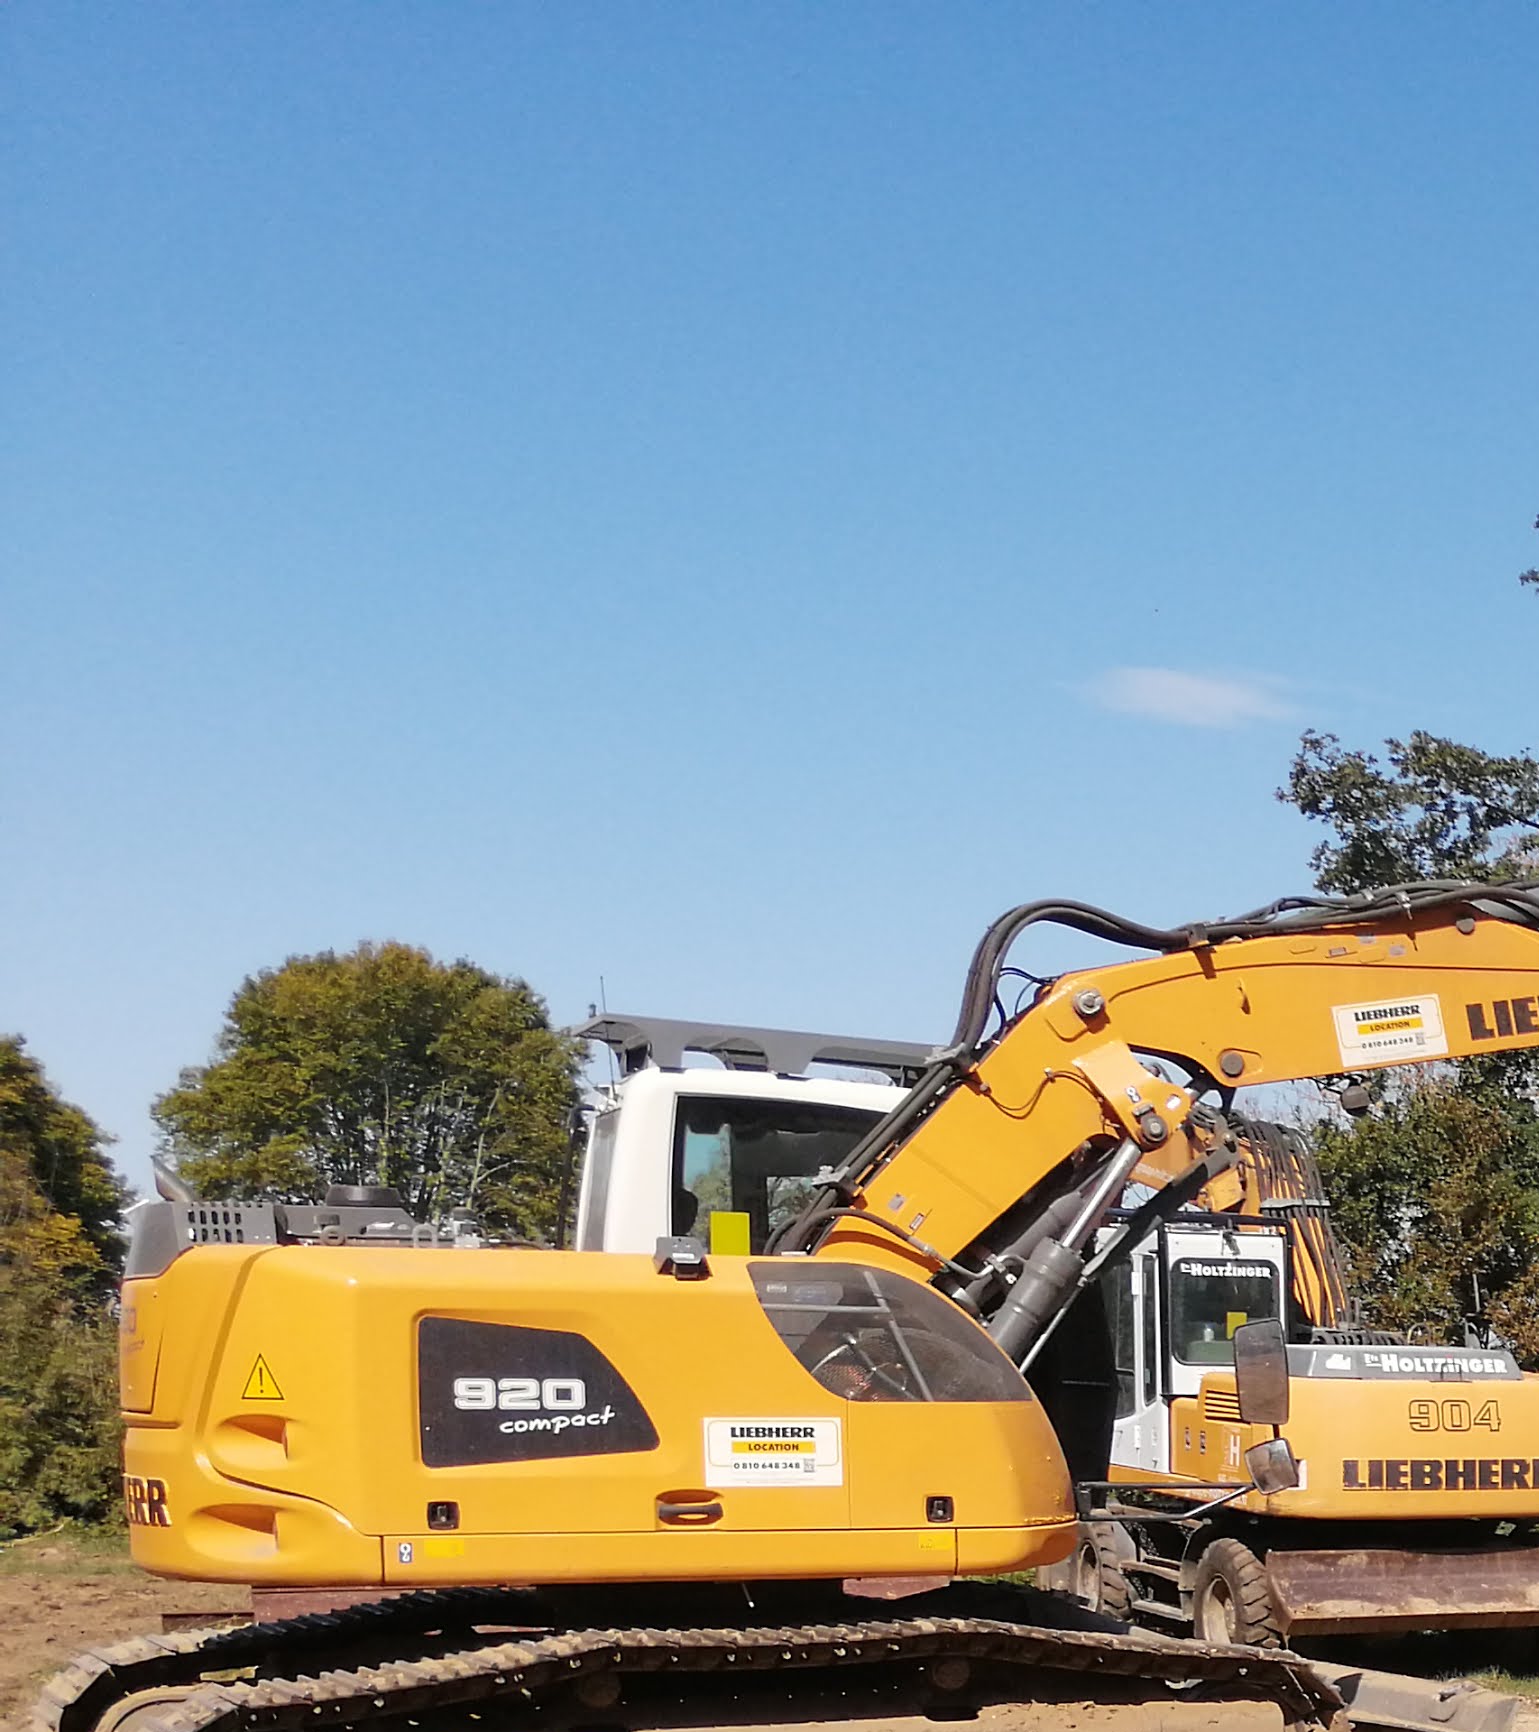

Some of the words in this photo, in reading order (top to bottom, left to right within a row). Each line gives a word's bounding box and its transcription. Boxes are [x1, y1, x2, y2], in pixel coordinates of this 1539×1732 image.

[1354, 1005, 1421, 1022] LIEBHERR
[1370, 1021, 1410, 1032] LOCATION
[454, 1377, 586, 1411] 920
[499, 1405, 616, 1435] compact
[1408, 1399, 1501, 1432] 904
[730, 1427, 815, 1438] LIEBHERR
[748, 1443, 800, 1452] LOCATION
